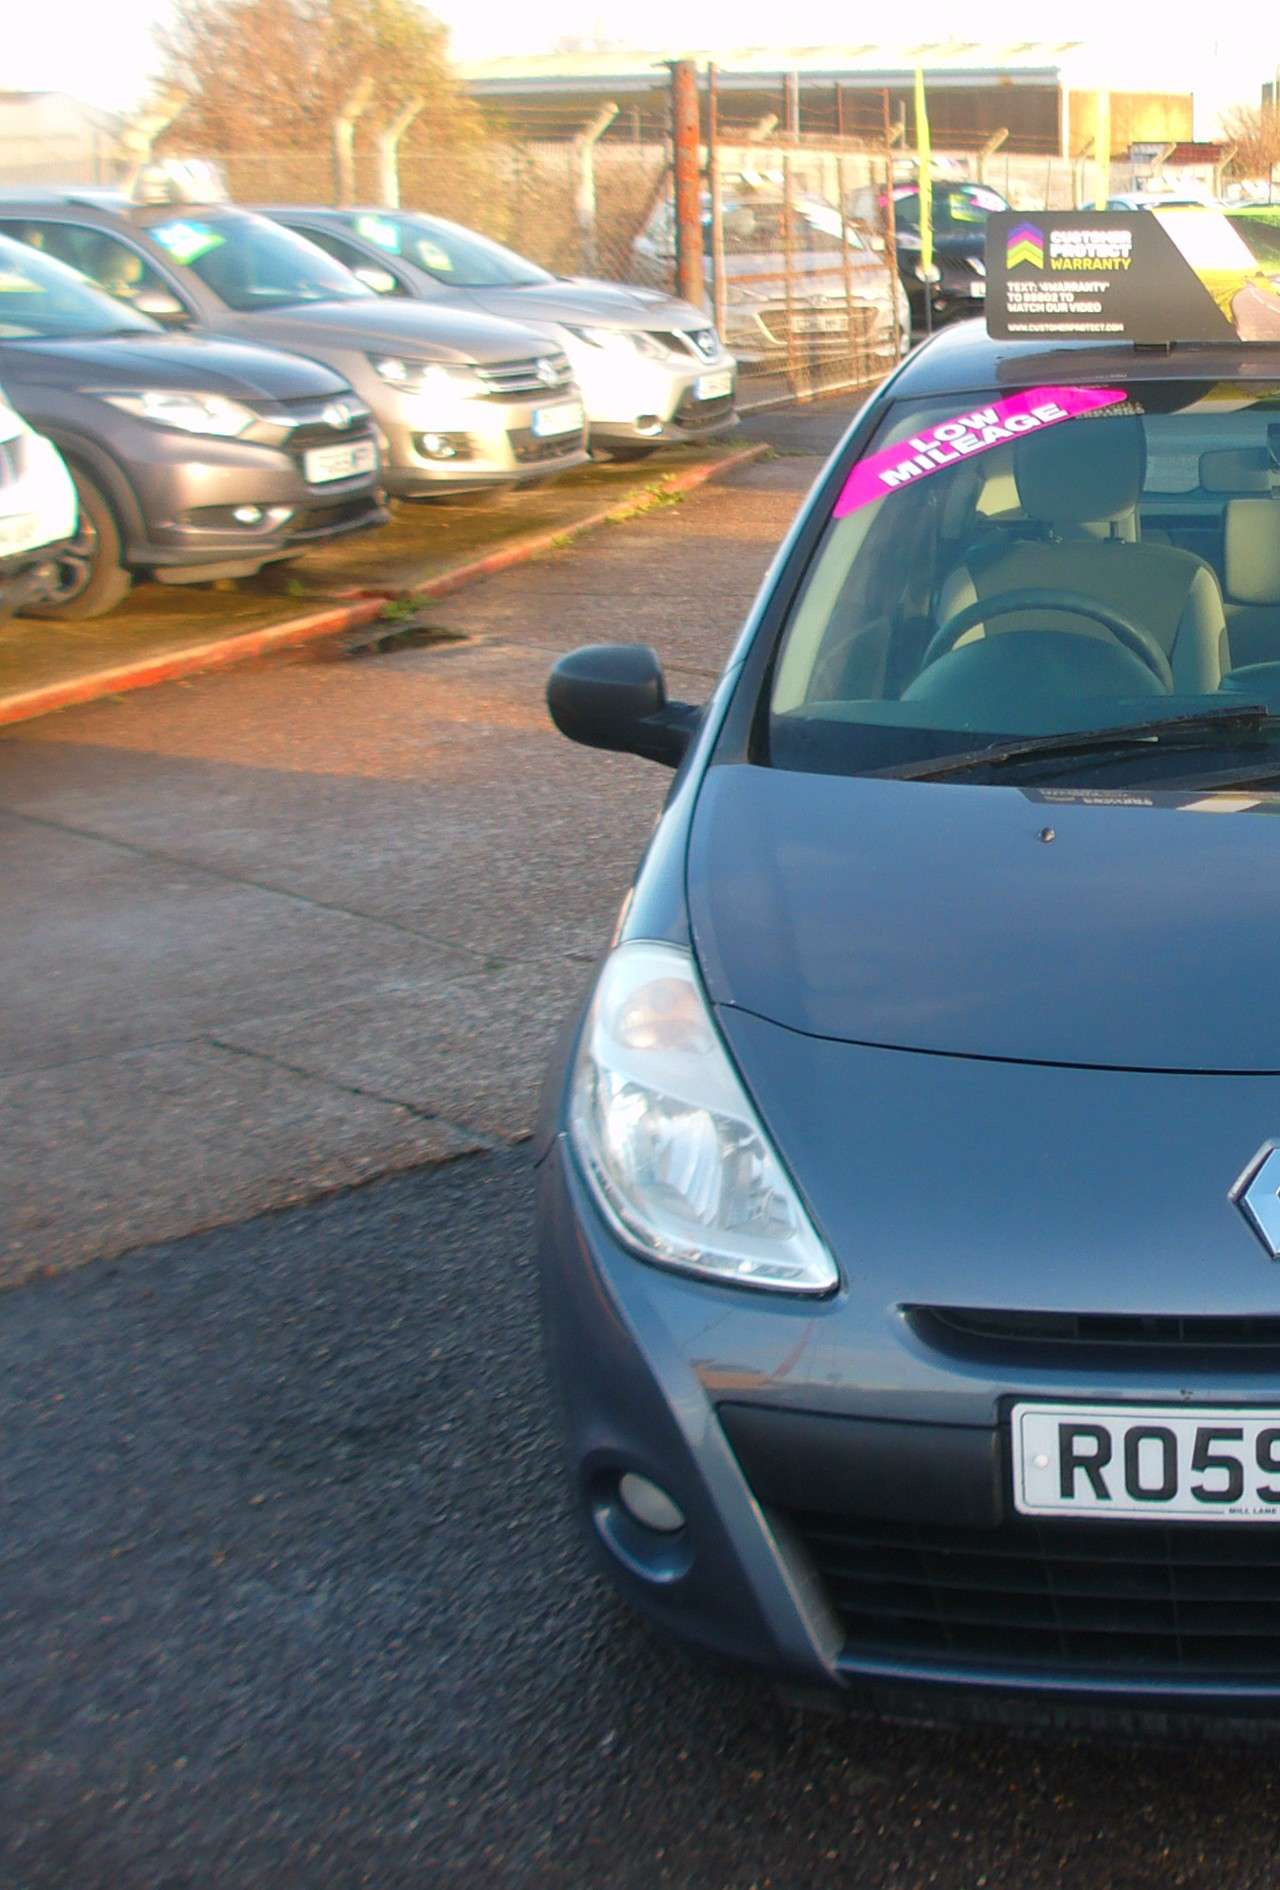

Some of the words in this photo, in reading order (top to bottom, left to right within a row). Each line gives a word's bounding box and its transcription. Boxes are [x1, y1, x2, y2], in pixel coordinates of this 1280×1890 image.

[1050, 243, 1132, 258] PROTECT
[1050, 258, 1132, 270] WARRANTY
[1007, 292, 1022, 302] TO
[1059, 292, 1075, 302] TO
[1007, 302, 1045, 312] WATCH
[1045, 302, 1069, 312] OUR
[1069, 302, 1102, 312] VIDEO
[909, 408, 1000, 453] LOW
[878, 403, 1068, 487] MILEAGE
